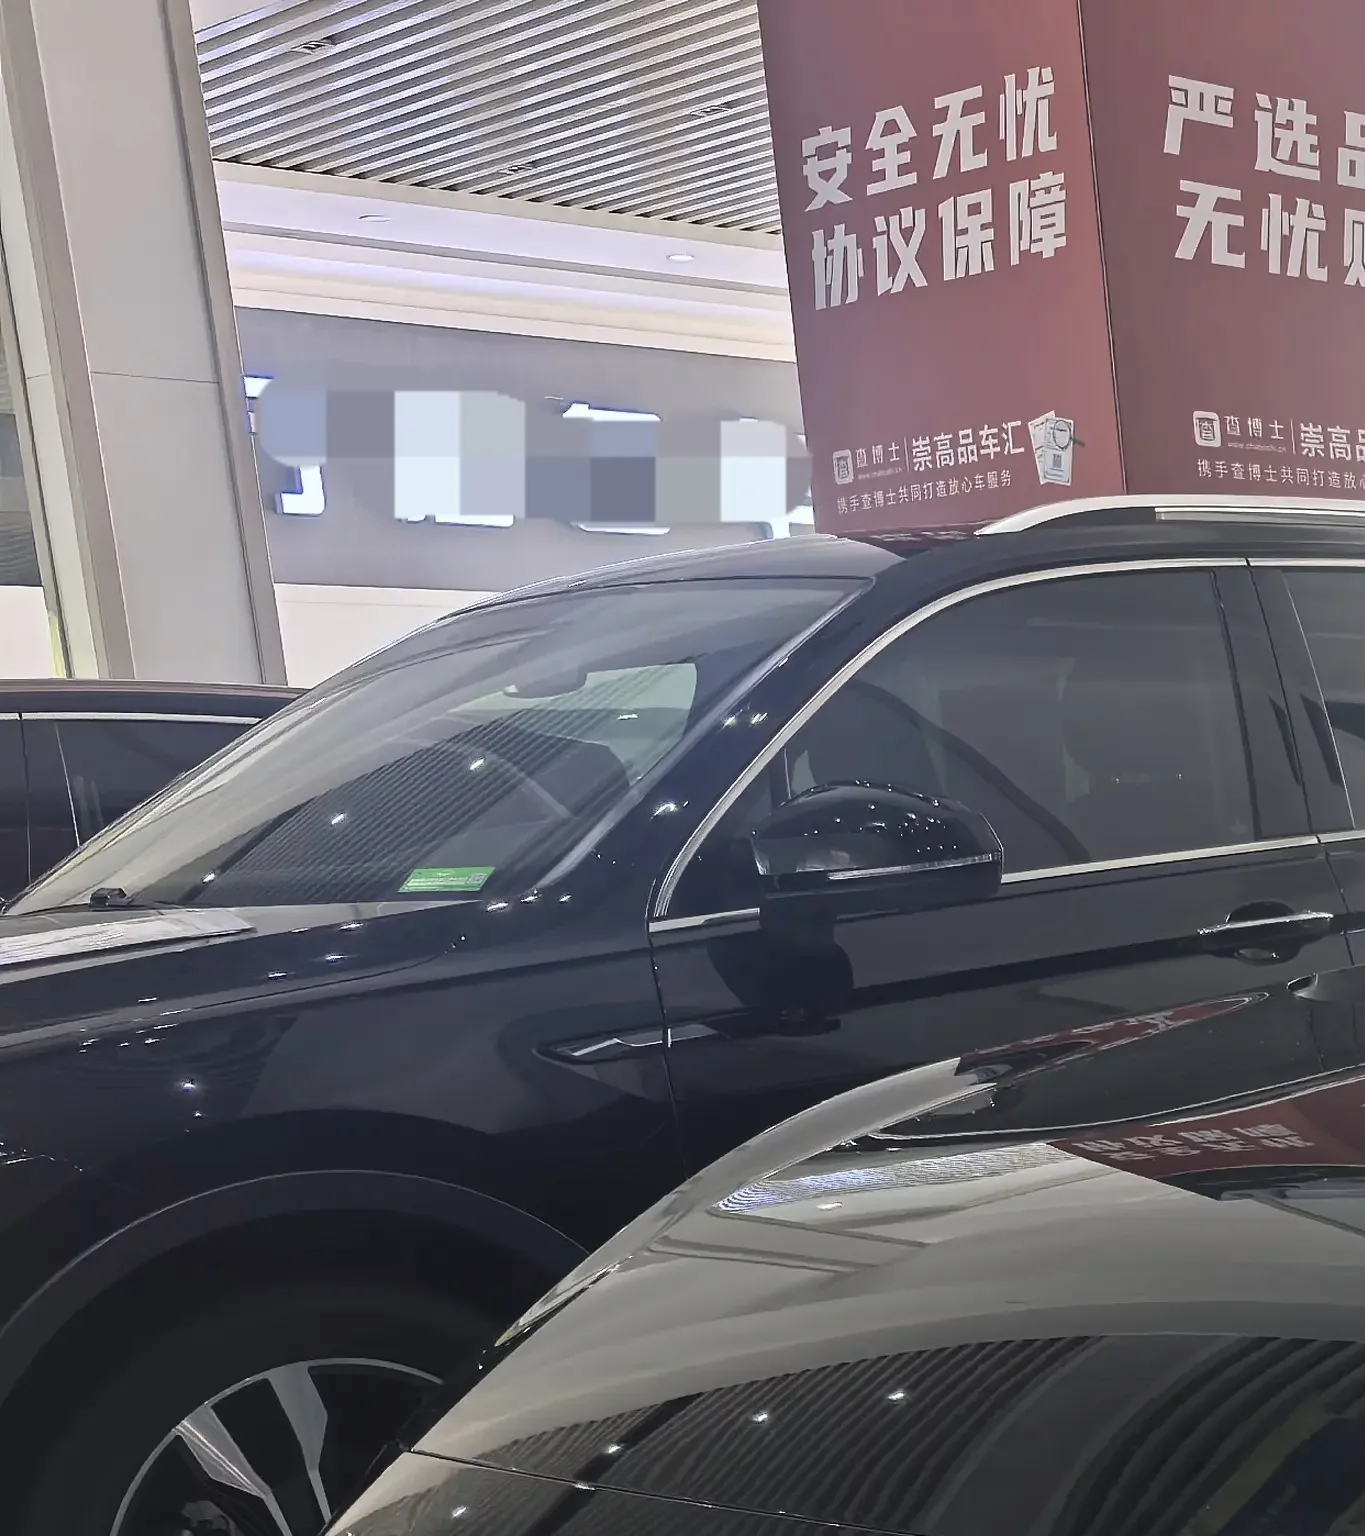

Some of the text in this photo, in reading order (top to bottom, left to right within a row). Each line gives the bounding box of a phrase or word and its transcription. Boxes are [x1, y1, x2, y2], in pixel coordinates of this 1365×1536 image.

[802, 66, 1058, 211] 安全无忧
[811, 171, 1067, 311] 协议保障
[911, 420, 1025, 472] 崇高品车汇
